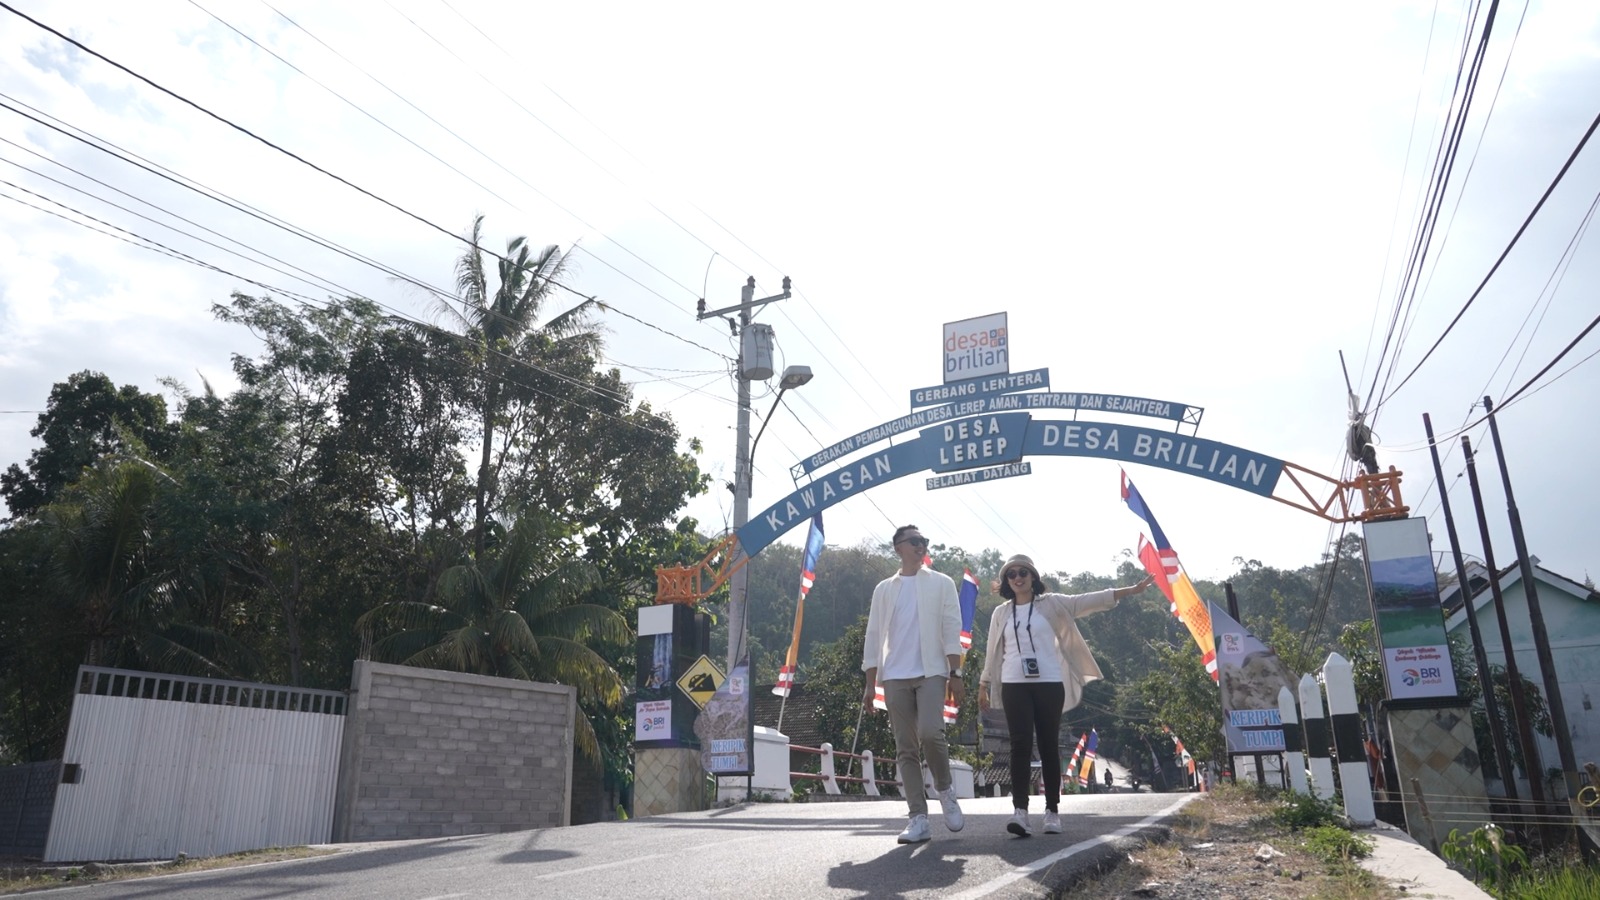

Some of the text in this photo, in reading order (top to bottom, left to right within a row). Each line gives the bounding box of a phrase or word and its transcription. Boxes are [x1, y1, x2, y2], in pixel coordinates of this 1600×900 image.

[945, 331, 990, 352] desa
[946, 347, 1007, 373] brilian
[915, 372, 1043, 402] GERBANG LENTERA
[811, 393, 1171, 468] GERAKAN PEMBANGUNAN DESA LEREP AMAN, TENTRAM DAN SEJAHTERA
[944, 417, 1000, 442] DESA
[940, 437, 1007, 465] LEREP
[766, 425, 1267, 531] KAWASAN DESA BRILIAN
[927, 463, 1029, 490] SELAMAT DATANG
[1420, 667, 1441, 679] BRI
[653, 717, 665, 726] BRI
[1230, 710, 1282, 726] KERIPIK
[711, 739, 745, 753] KERIPIK
[1243, 730, 1284, 747] TUMPI
